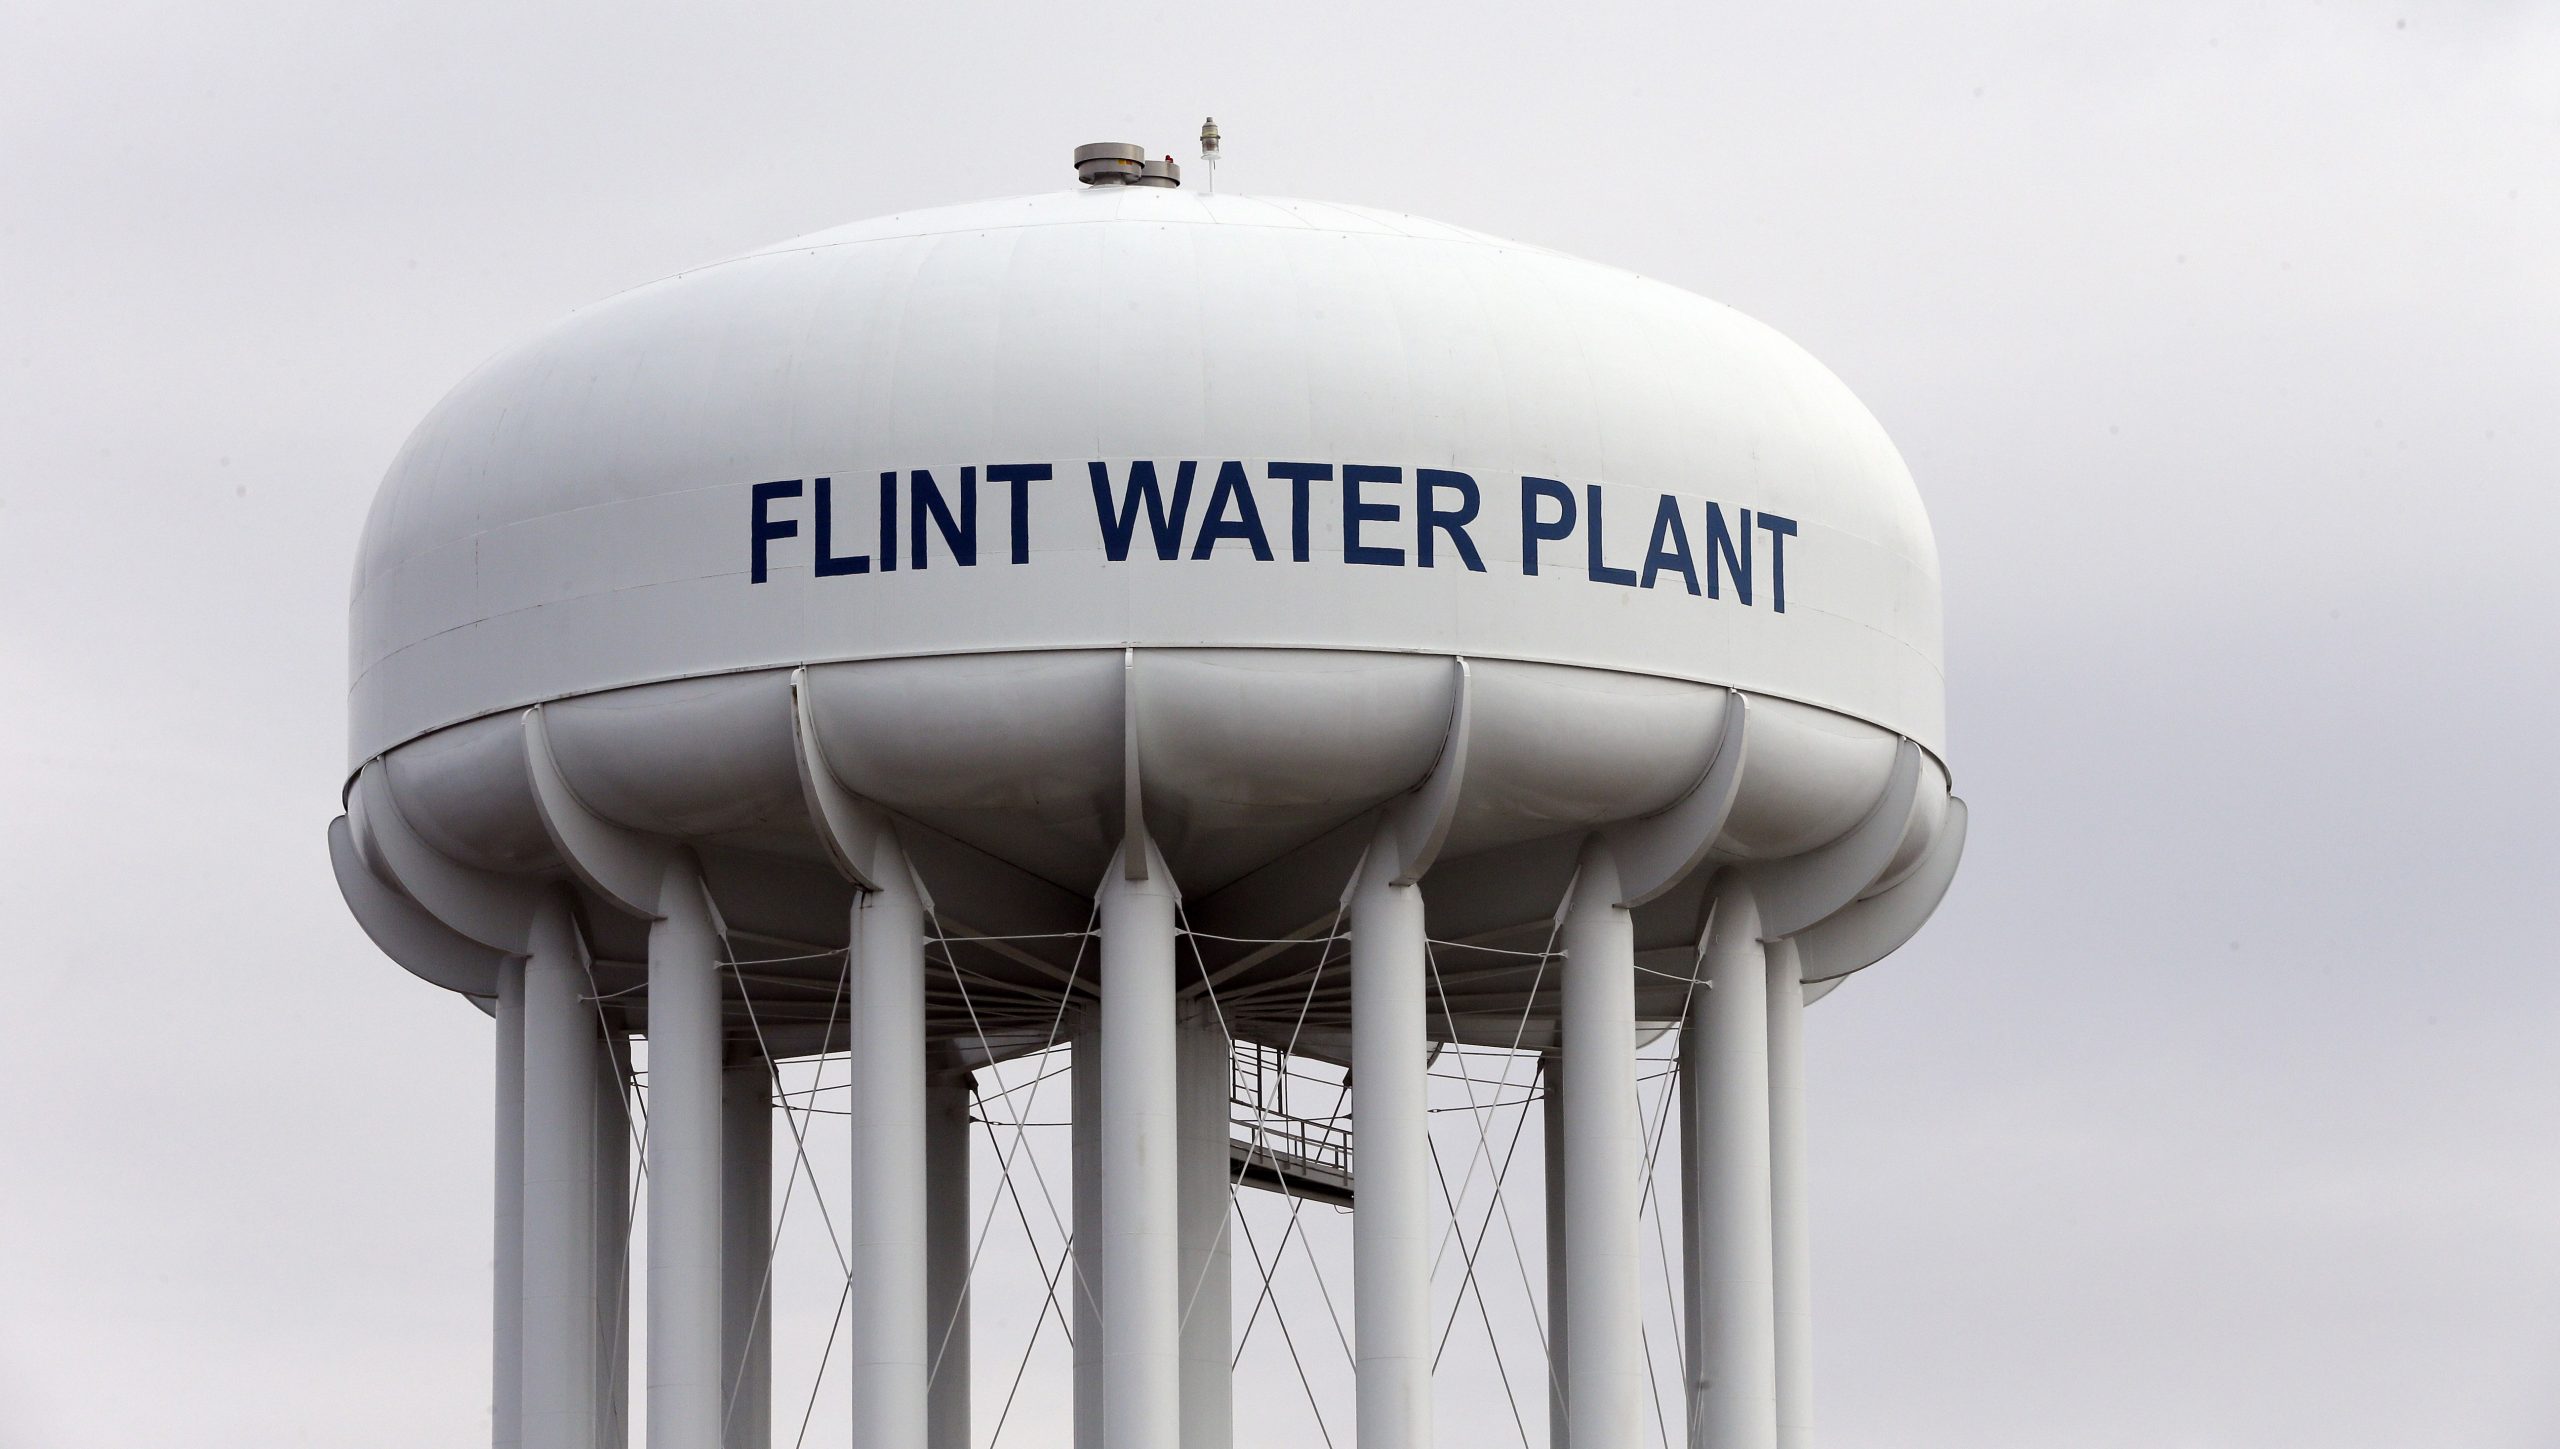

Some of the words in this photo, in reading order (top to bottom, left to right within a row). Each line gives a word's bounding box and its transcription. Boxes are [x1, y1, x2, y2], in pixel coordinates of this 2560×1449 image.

[751, 463, 1053, 585] FLINT
[1088, 460, 1487, 573] WATER
[1521, 476, 1799, 613] PLANT
